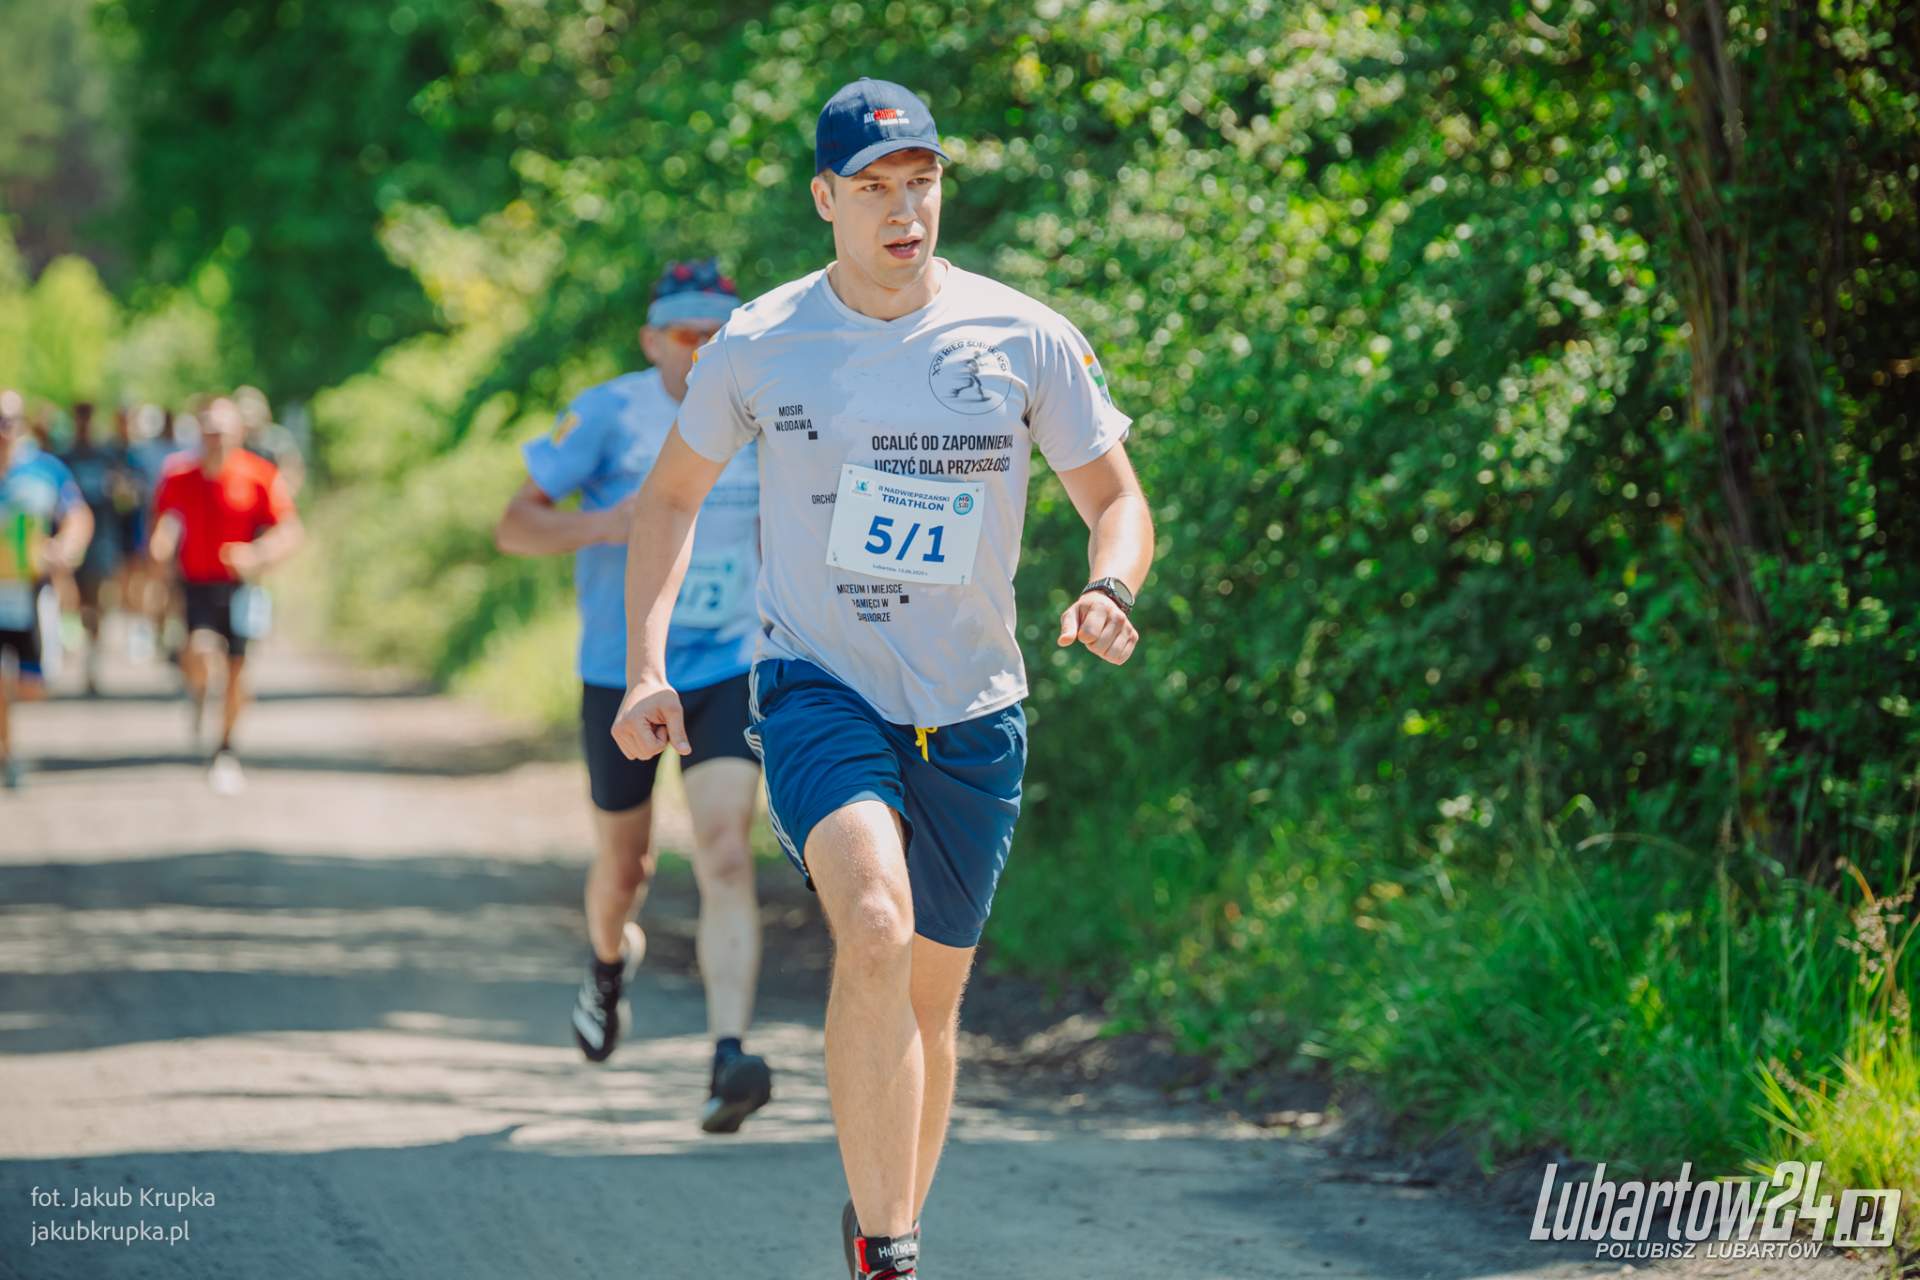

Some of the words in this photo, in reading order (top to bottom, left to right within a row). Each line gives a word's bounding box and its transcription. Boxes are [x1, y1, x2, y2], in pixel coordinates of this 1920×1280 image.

[778, 404, 804, 417] MOSIR
[774, 418, 813, 432] WŁODAWA
[871, 432, 918, 451] OCALIĆ
[921, 434, 939, 451] OD
[874, 456, 917, 475] UCZYĆ
[919, 459, 945, 475] DLA
[881, 493, 945, 512] TRIATHLON
[864, 515, 945, 563] 5/1
[871, 583, 904, 594] MIEJSCE
[881, 598, 889, 608] W
